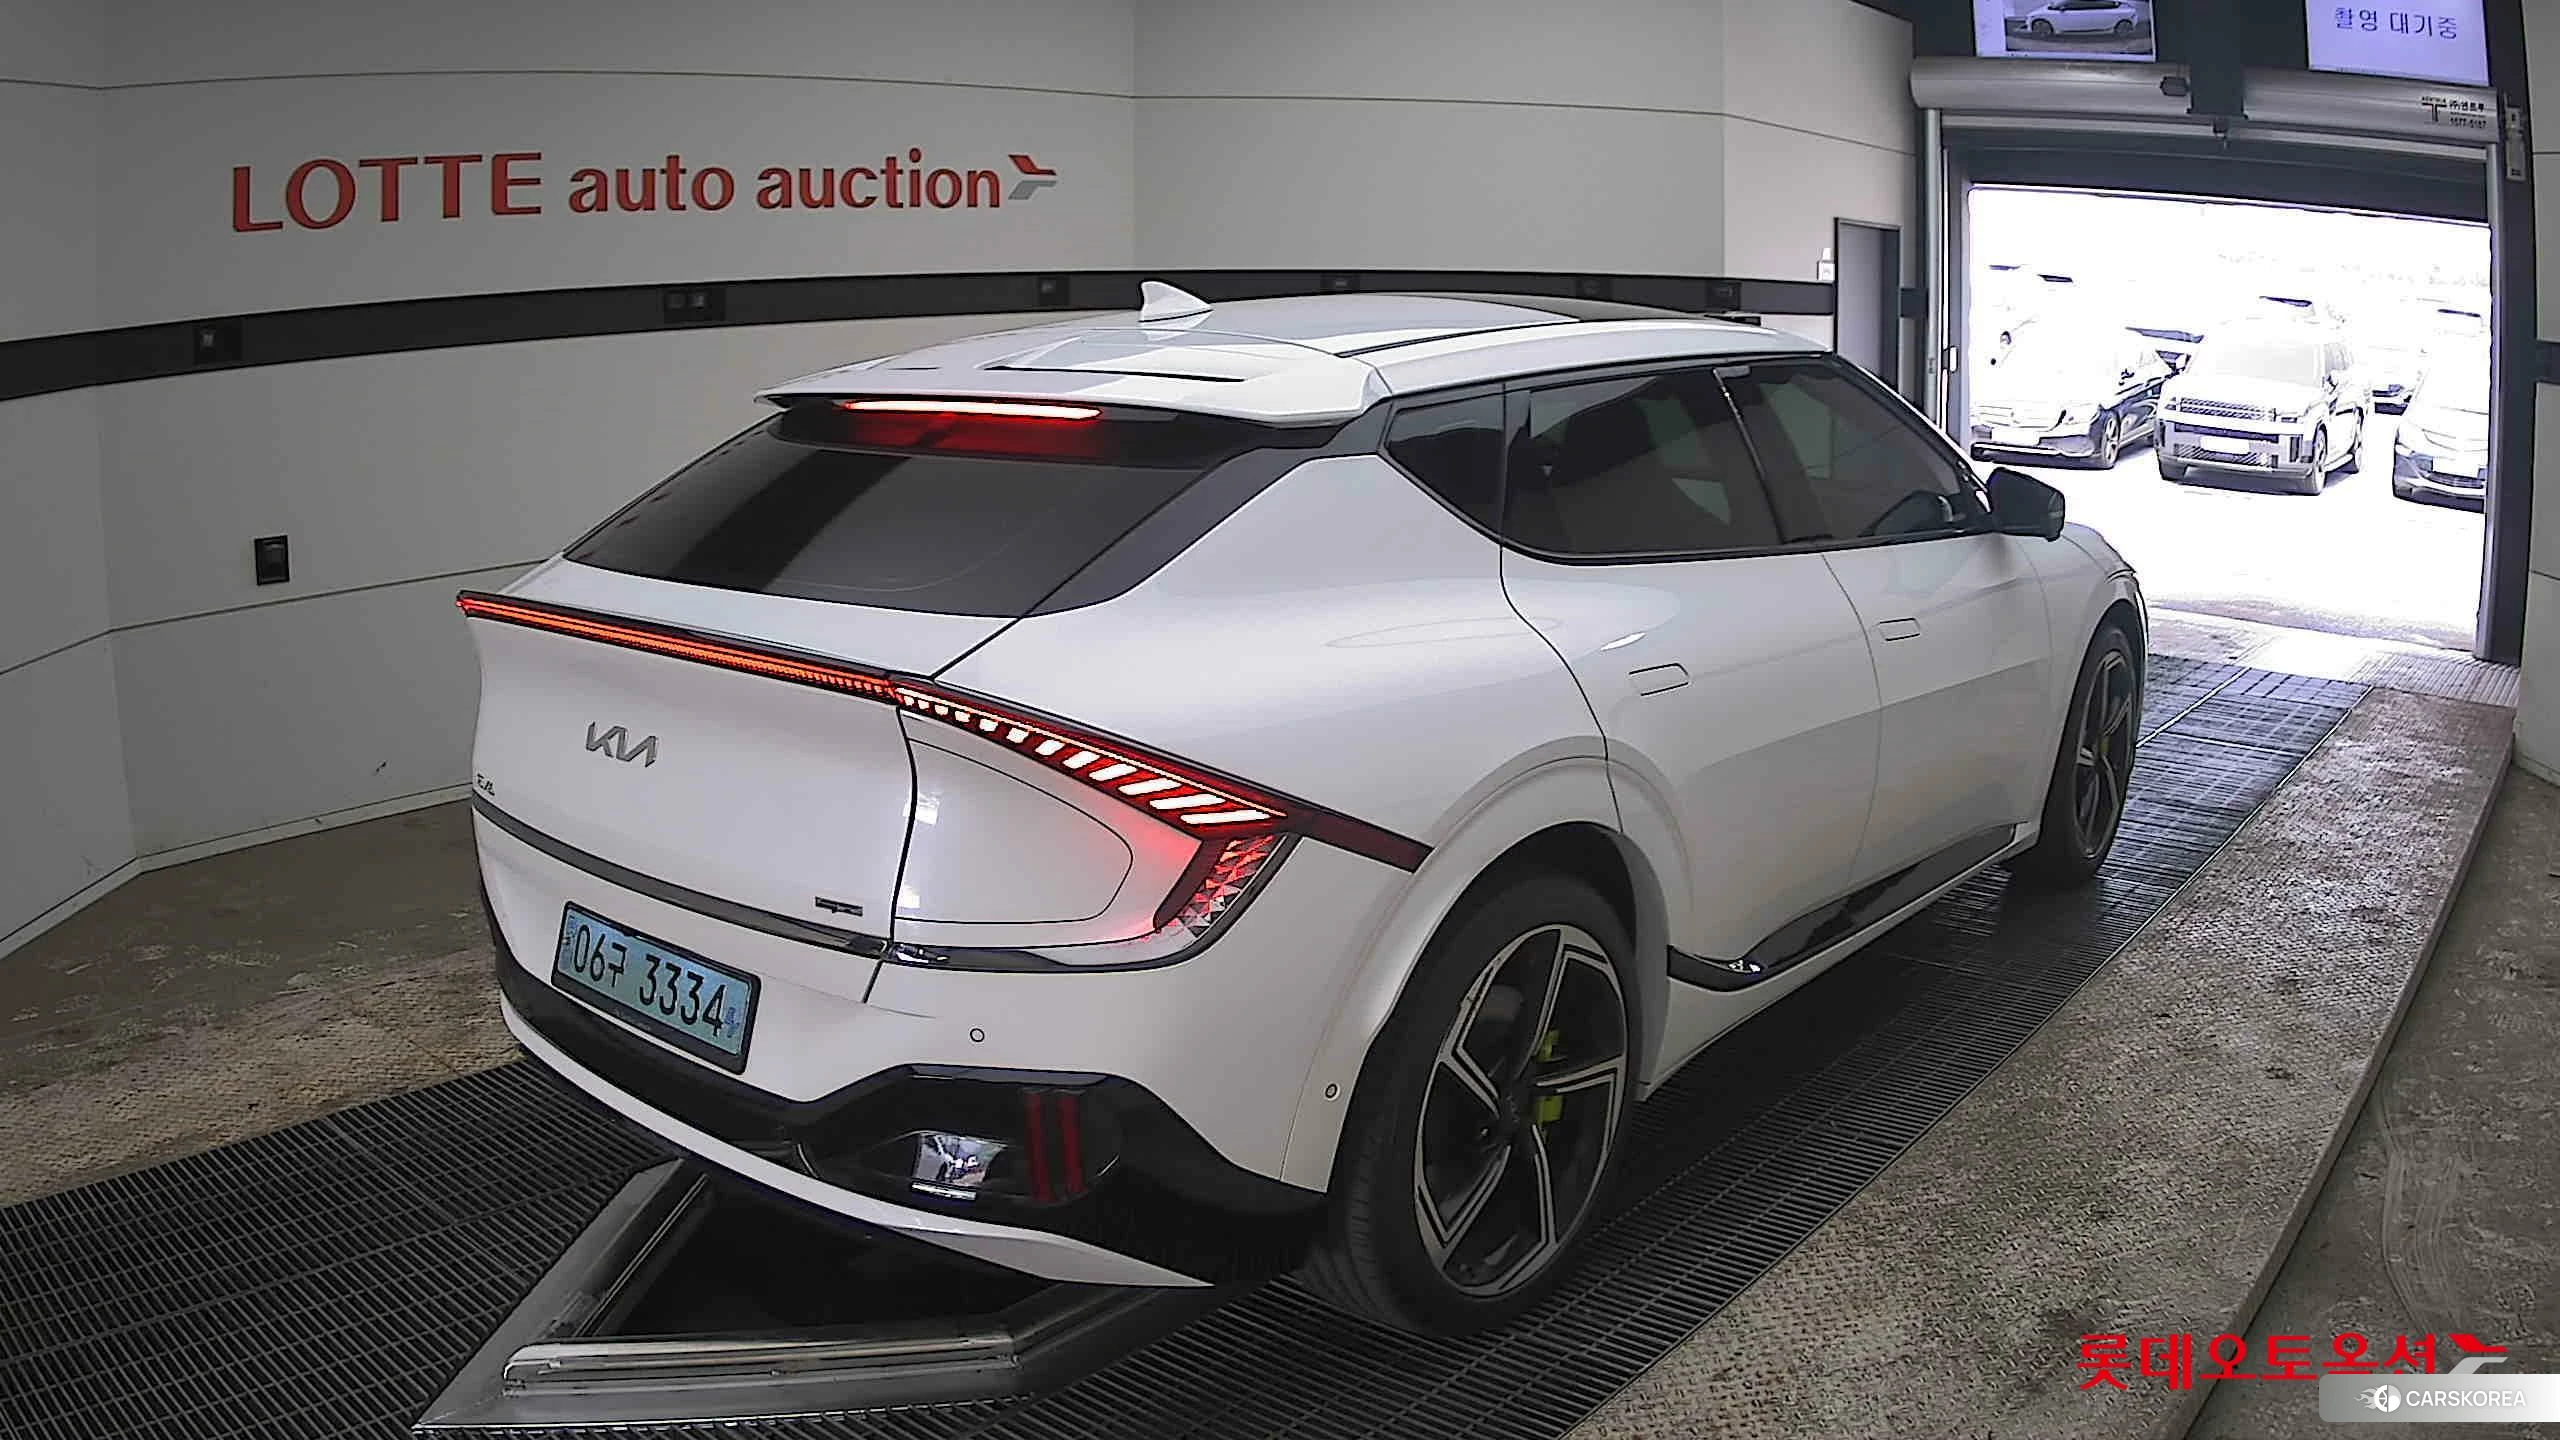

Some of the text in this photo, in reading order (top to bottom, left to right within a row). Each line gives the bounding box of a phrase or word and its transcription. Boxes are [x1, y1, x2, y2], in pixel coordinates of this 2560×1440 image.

[2390, 12, 2457, 40] 대기중
[233, 147, 1002, 232] LOTTE auto auction
[585, 721, 658, 768] KIA
[573, 924, 628, 989] 06구
[638, 953, 724, 1038] 3334
